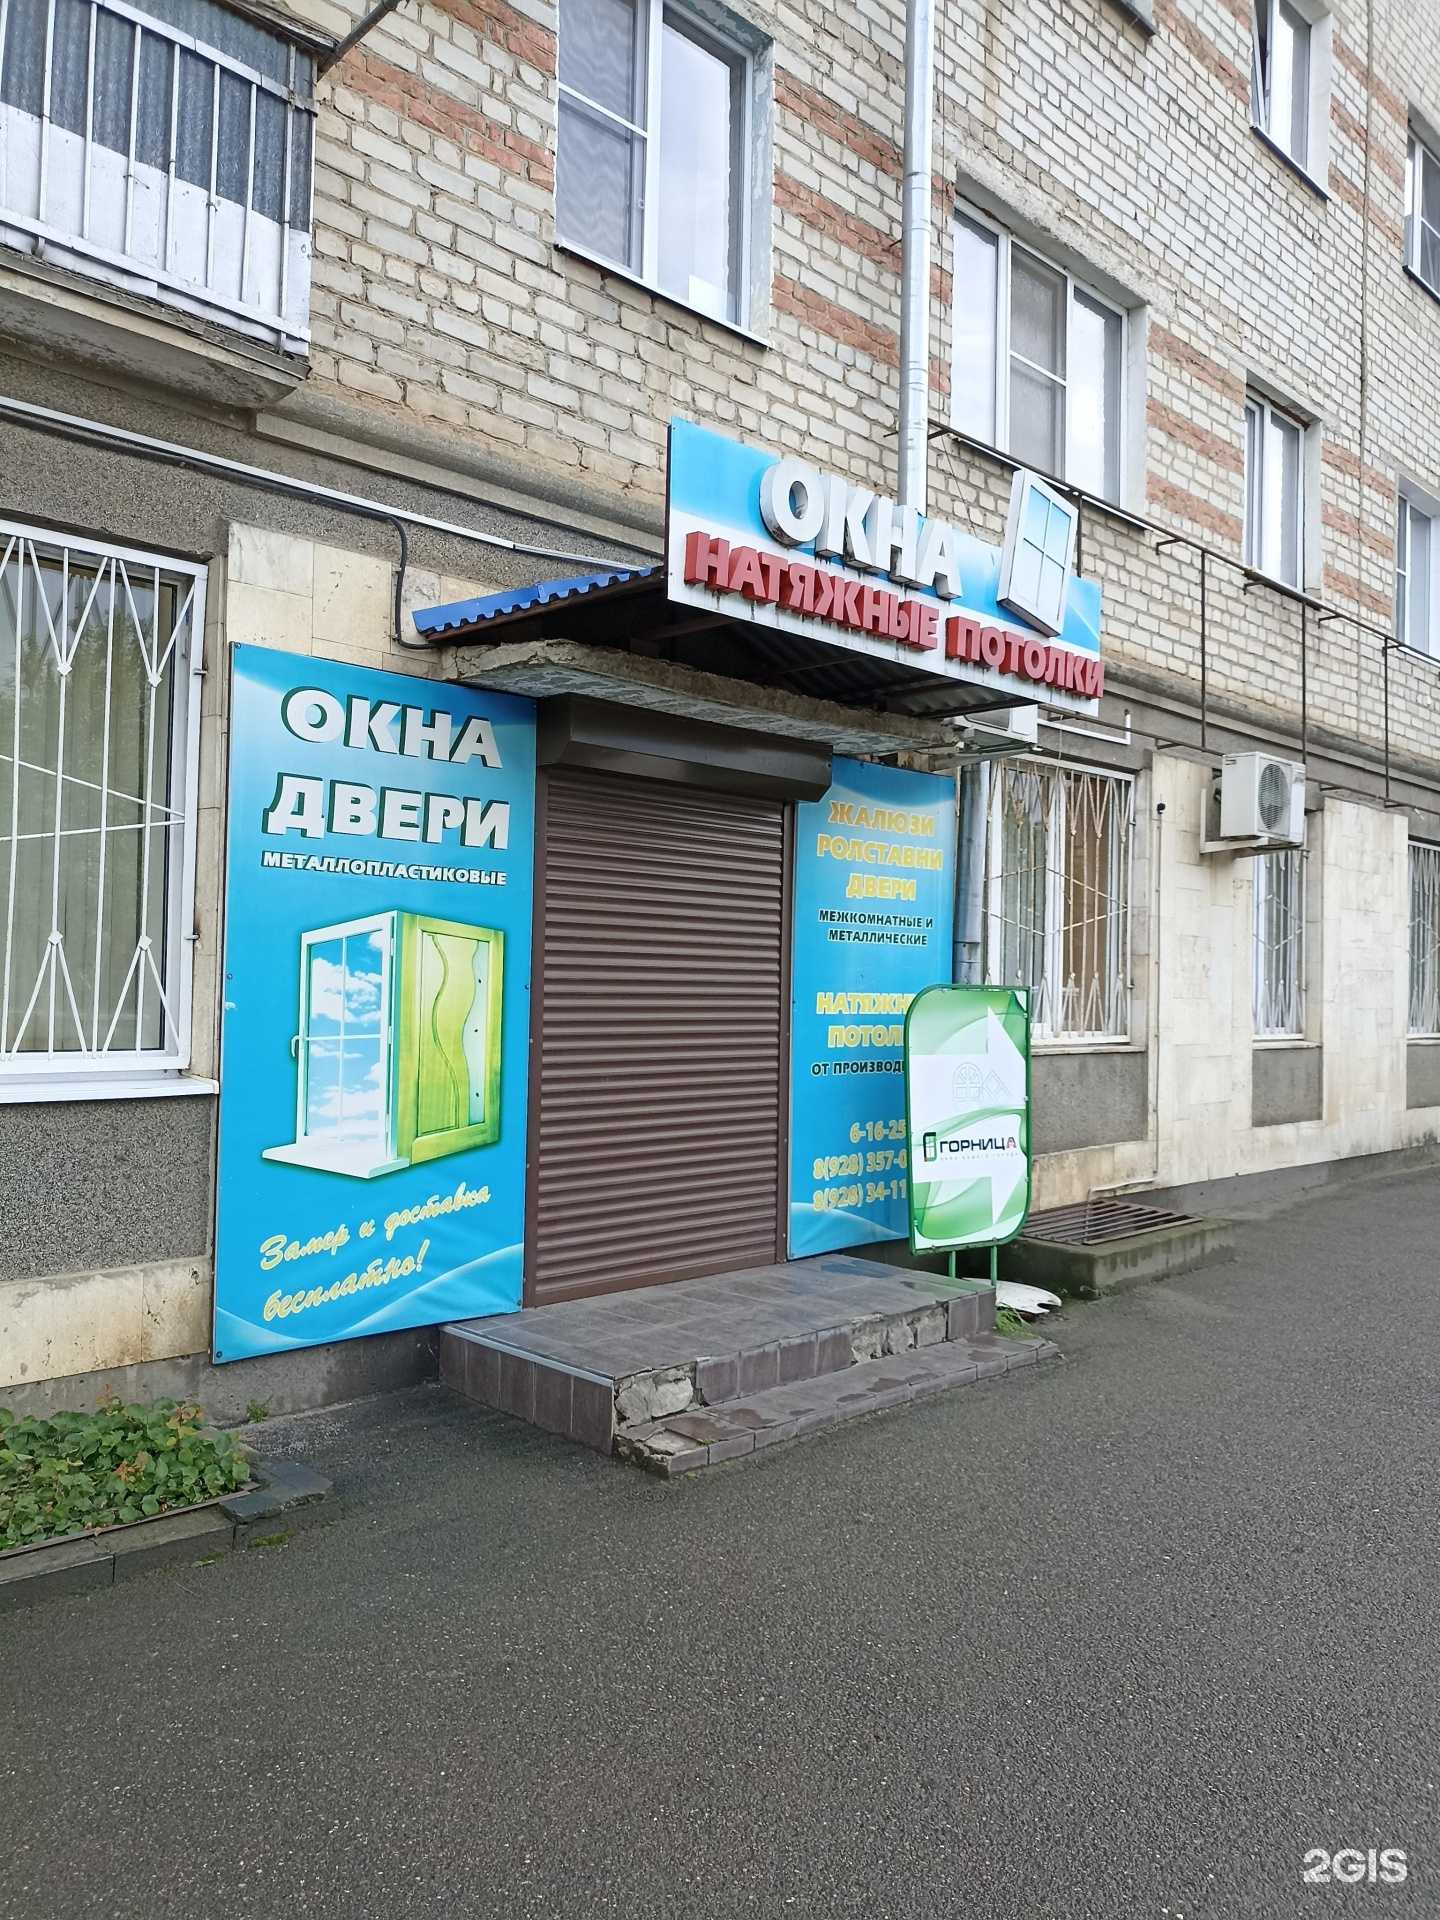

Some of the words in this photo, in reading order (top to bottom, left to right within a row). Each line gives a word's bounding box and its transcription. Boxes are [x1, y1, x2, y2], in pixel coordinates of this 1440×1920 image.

[759, 459, 962, 600] ОКНА
[684, 531, 940, 650] НАТЯЖНЫЕ
[945, 616, 1104, 699] ПОТОЛКИ
[281, 686, 503, 768] ОКНА
[262, 772, 511, 849] ДВЕРИ
[828, 800, 935, 837] ЖАЛЮЗИ
[261, 850, 507, 886] МЕТАЛЛОПЛАСТИКОВЫЕ
[816, 833, 944, 871] РОЛСТАВНИ
[846, 873, 917, 901] ДВЕРИ
[819, 909, 922, 928] МЕЖКОМНАТНЫЕ
[925, 918, 934, 929] И
[828, 929, 928, 946] МЕТАЛЛИЧЕСКИЕ
[828, 1025, 904, 1048] ПОТОЛ
[811, 1062, 829, 1076] ОТ
[833, 1060, 904, 1075] ПРОИЗВОД
[940, 1136, 1017, 1153] ГОРНИЦА
[260, 1223, 349, 1271] Замер
[358, 1219, 376, 1239] и
[384, 1182, 491, 1241] доставка
[263, 1239, 430, 1322] бесплатно!
